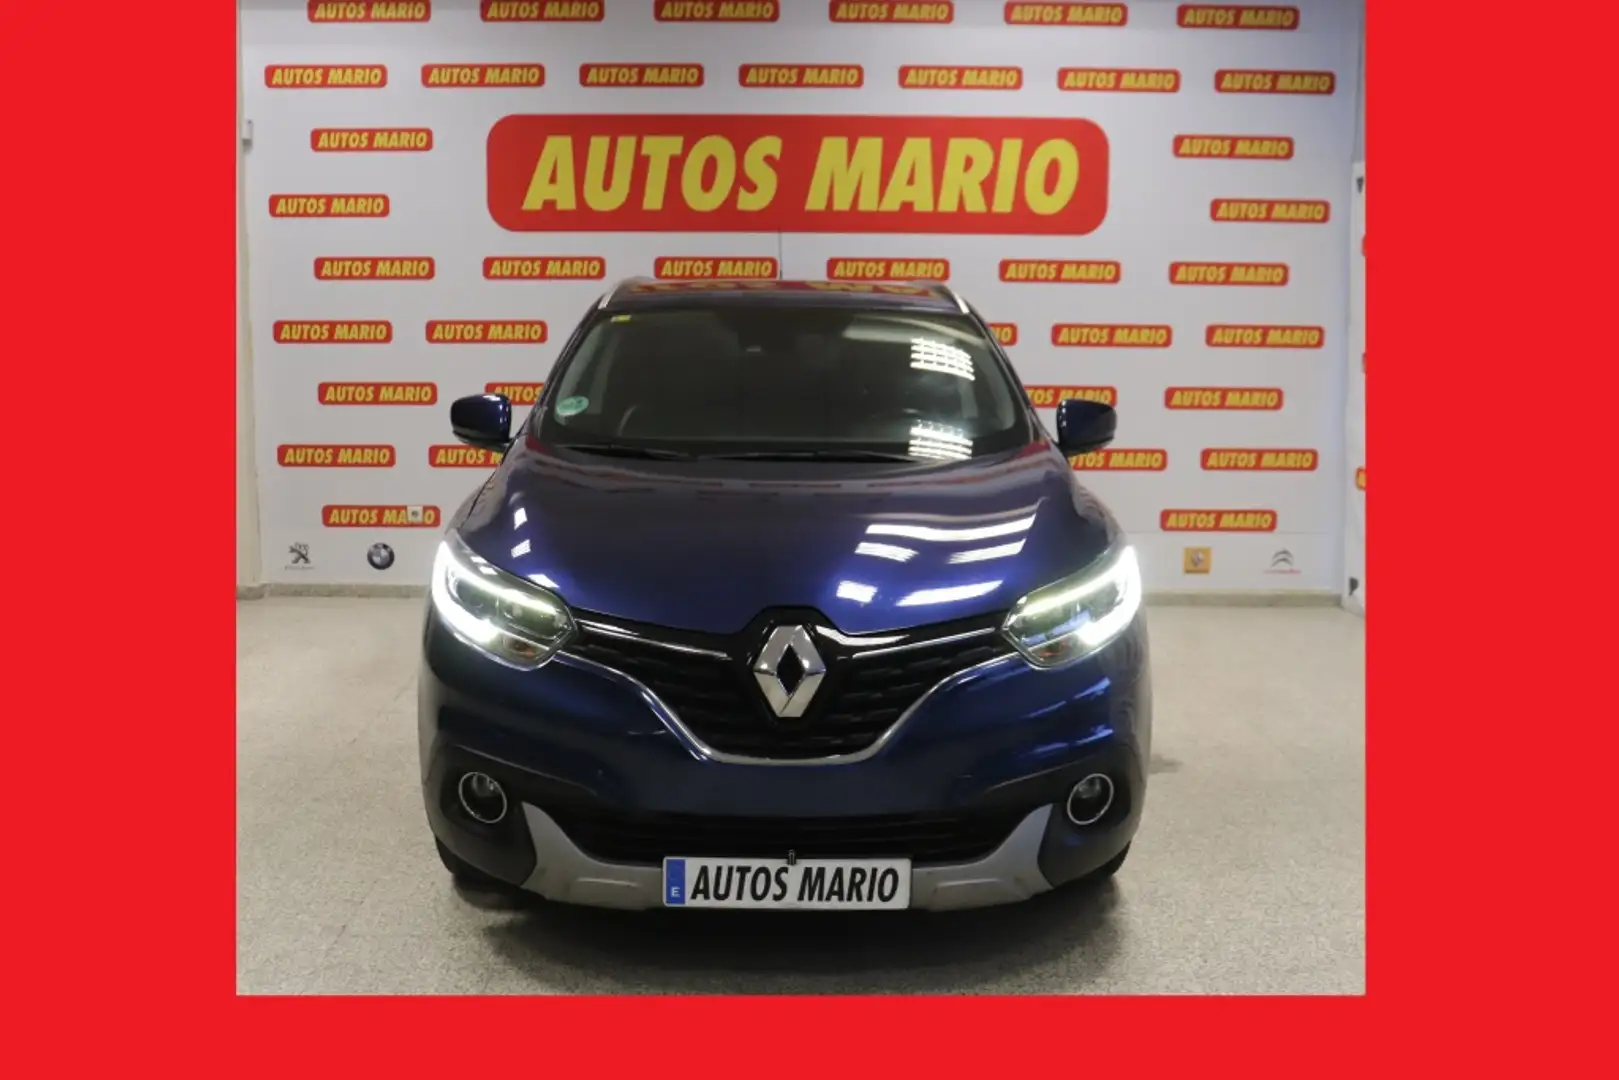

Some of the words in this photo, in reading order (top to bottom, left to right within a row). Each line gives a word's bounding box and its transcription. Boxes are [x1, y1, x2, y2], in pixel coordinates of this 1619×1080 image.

[315, 1, 367, 20] AUTOS
[371, 1, 426, 20] MARIO
[488, 1, 540, 19] AUTOS
[544, 1, 600, 19] MARIO
[661, 0, 714, 18] AUTOS
[718, 0, 774, 18] MARIO
[835, 2, 888, 20] AUTOS
[892, 2, 949, 20] MARIO
[1012, 4, 1064, 23] AUTOS
[1068, 4, 1123, 23] MARIO
[1183, 8, 1234, 26] AUTOS
[1238, 8, 1293, 26] MARIO
[271, 67, 323, 86] AUTOS
[327, 67, 382, 86] MARIO
[428, 66, 481, 84] AUTOS
[485, 66, 541, 84] MARIO
[586, 67, 639, 84] AUTOS
[643, 67, 699, 84] MARIO
[746, 67, 799, 85] AUTOS
[803, 67, 860, 85] MARIO
[905, 68, 958, 87] AUTOS
[962, 68, 1019, 87] MARIO
[1064, 70, 1116, 90] AUTOS
[1120, 70, 1176, 90] MARIO
[1221, 73, 1272, 91] AUTOS
[1276, 73, 1331, 91] MARIO
[317, 131, 369, 150] AUTOS
[373, 131, 428, 150] MARIO
[1179, 137, 1231, 156] AUTOS
[1235, 137, 1290, 156] MARIO
[522, 135, 783, 212] AUTOS
[804, 136, 1080, 216] MARIO
[275, 197, 327, 215] AUTOS
[331, 197, 386, 215] MARIO
[1216, 201, 1267, 220] AUTOS
[1271, 201, 1326, 220] MARIO
[321, 259, 372, 277] AUTOS
[376, 259, 430, 277] MARIO
[489, 259, 541, 277] AUTOS
[545, 259, 601, 277] MARIO
[661, 259, 713, 277] AUTOS
[717, 259, 773, 277] MARIO
[834, 260, 886, 278] AUTOS
[890, 260, 945, 278] MARIO
[1005, 261, 1057, 281] AUTOS
[1061, 261, 1117, 281] MARIO
[1175, 264, 1226, 283] AUTOS
[1230, 264, 1285, 283] MARIO
[280, 323, 331, 341] AUTOS
[334, 323, 388, 341] MARIO
[431, 323, 483, 341] AUTOS
[487, 323, 543, 341] MARIO
[1058, 326, 1109, 345] AUTOS
[1113, 326, 1168, 345] MARIO
[1212, 327, 1263, 346] AUTOS
[1266, 327, 1320, 346] MARIO
[325, 385, 376, 403] AUTOS
[379, 385, 433, 403] MARIO
[1170, 389, 1221, 408] AUTOS
[1225, 389, 1279, 408] MARIO
[283, 446, 334, 465] AUTOS
[337, 446, 391, 465] MARIO
[435, 447, 487, 465] AUTOS
[1109, 451, 1164, 468] MARIO
[1206, 450, 1257, 469] AUTOS
[1260, 450, 1314, 469] MARIO
[328, 508, 378, 525] AUTOS
[382, 508, 435, 525] MAO
[1166, 511, 1216, 530] AUTOS
[1220, 511, 1273, 530] MARIO
[690, 865, 790, 901] AUTOS
[797, 866, 900, 903] MARIO
